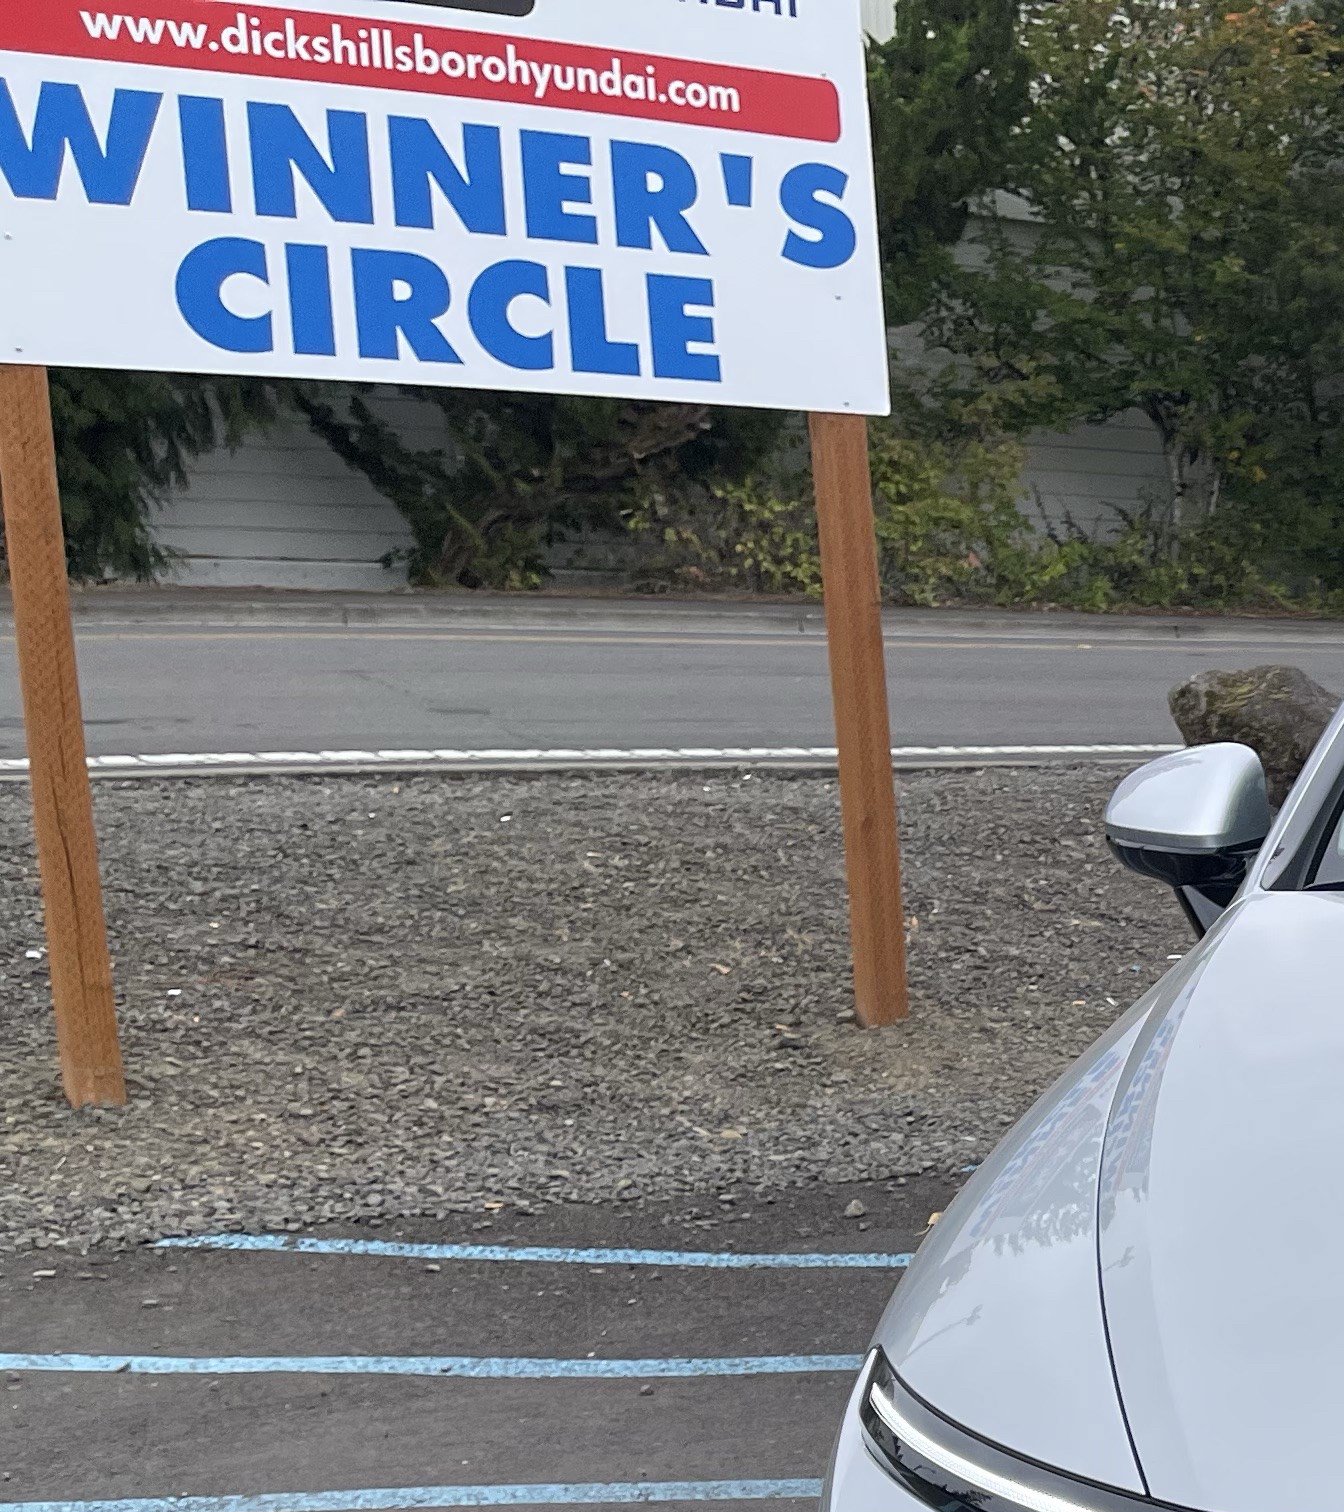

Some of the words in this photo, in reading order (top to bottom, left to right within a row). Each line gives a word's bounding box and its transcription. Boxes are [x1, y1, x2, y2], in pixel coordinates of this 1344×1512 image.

[80, 10, 741, 113] www.dickshillsborohyundai.com
[0, 78, 857, 269] WINNER'S
[174, 236, 723, 383] CIRCLE
